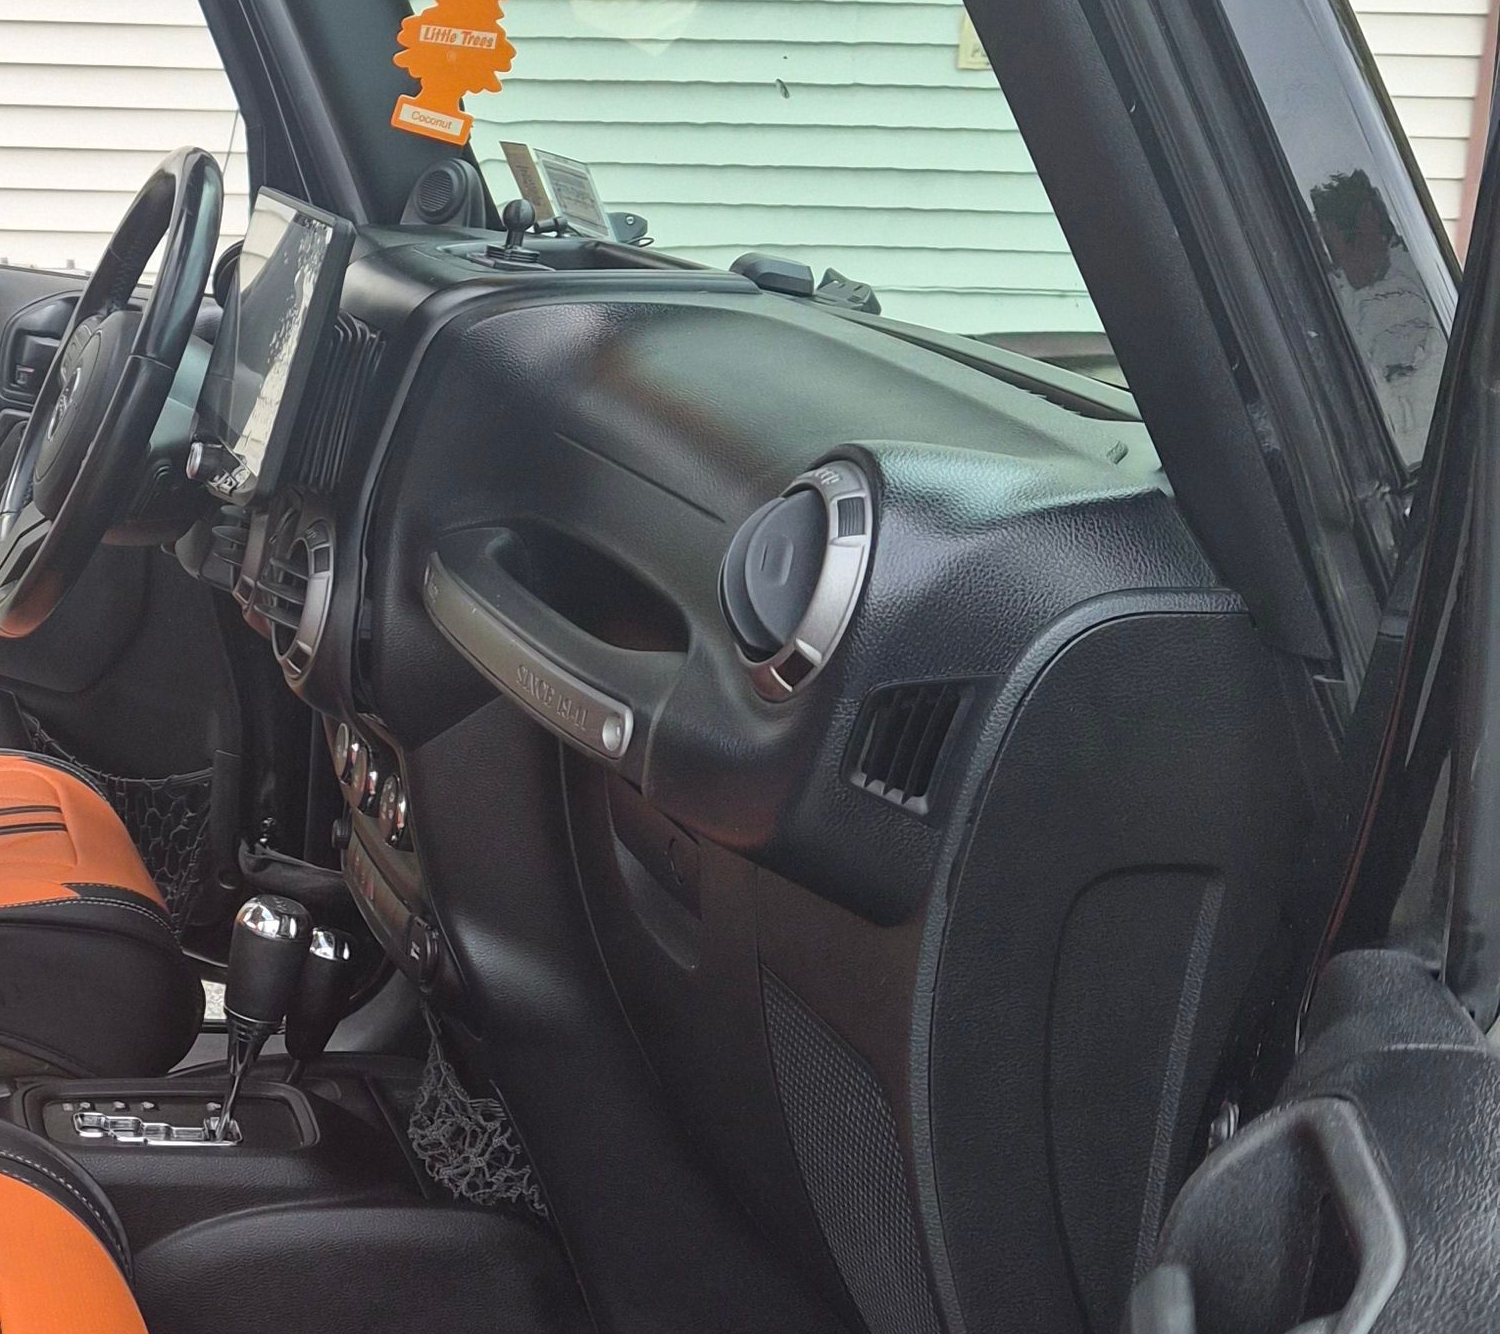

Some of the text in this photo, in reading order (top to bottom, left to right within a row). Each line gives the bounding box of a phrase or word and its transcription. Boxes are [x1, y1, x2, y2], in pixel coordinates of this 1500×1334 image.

[423, 27, 494, 47] Little Trees
[411, 111, 452, 130] Coconut
[516, 664, 555, 708] SINCE
